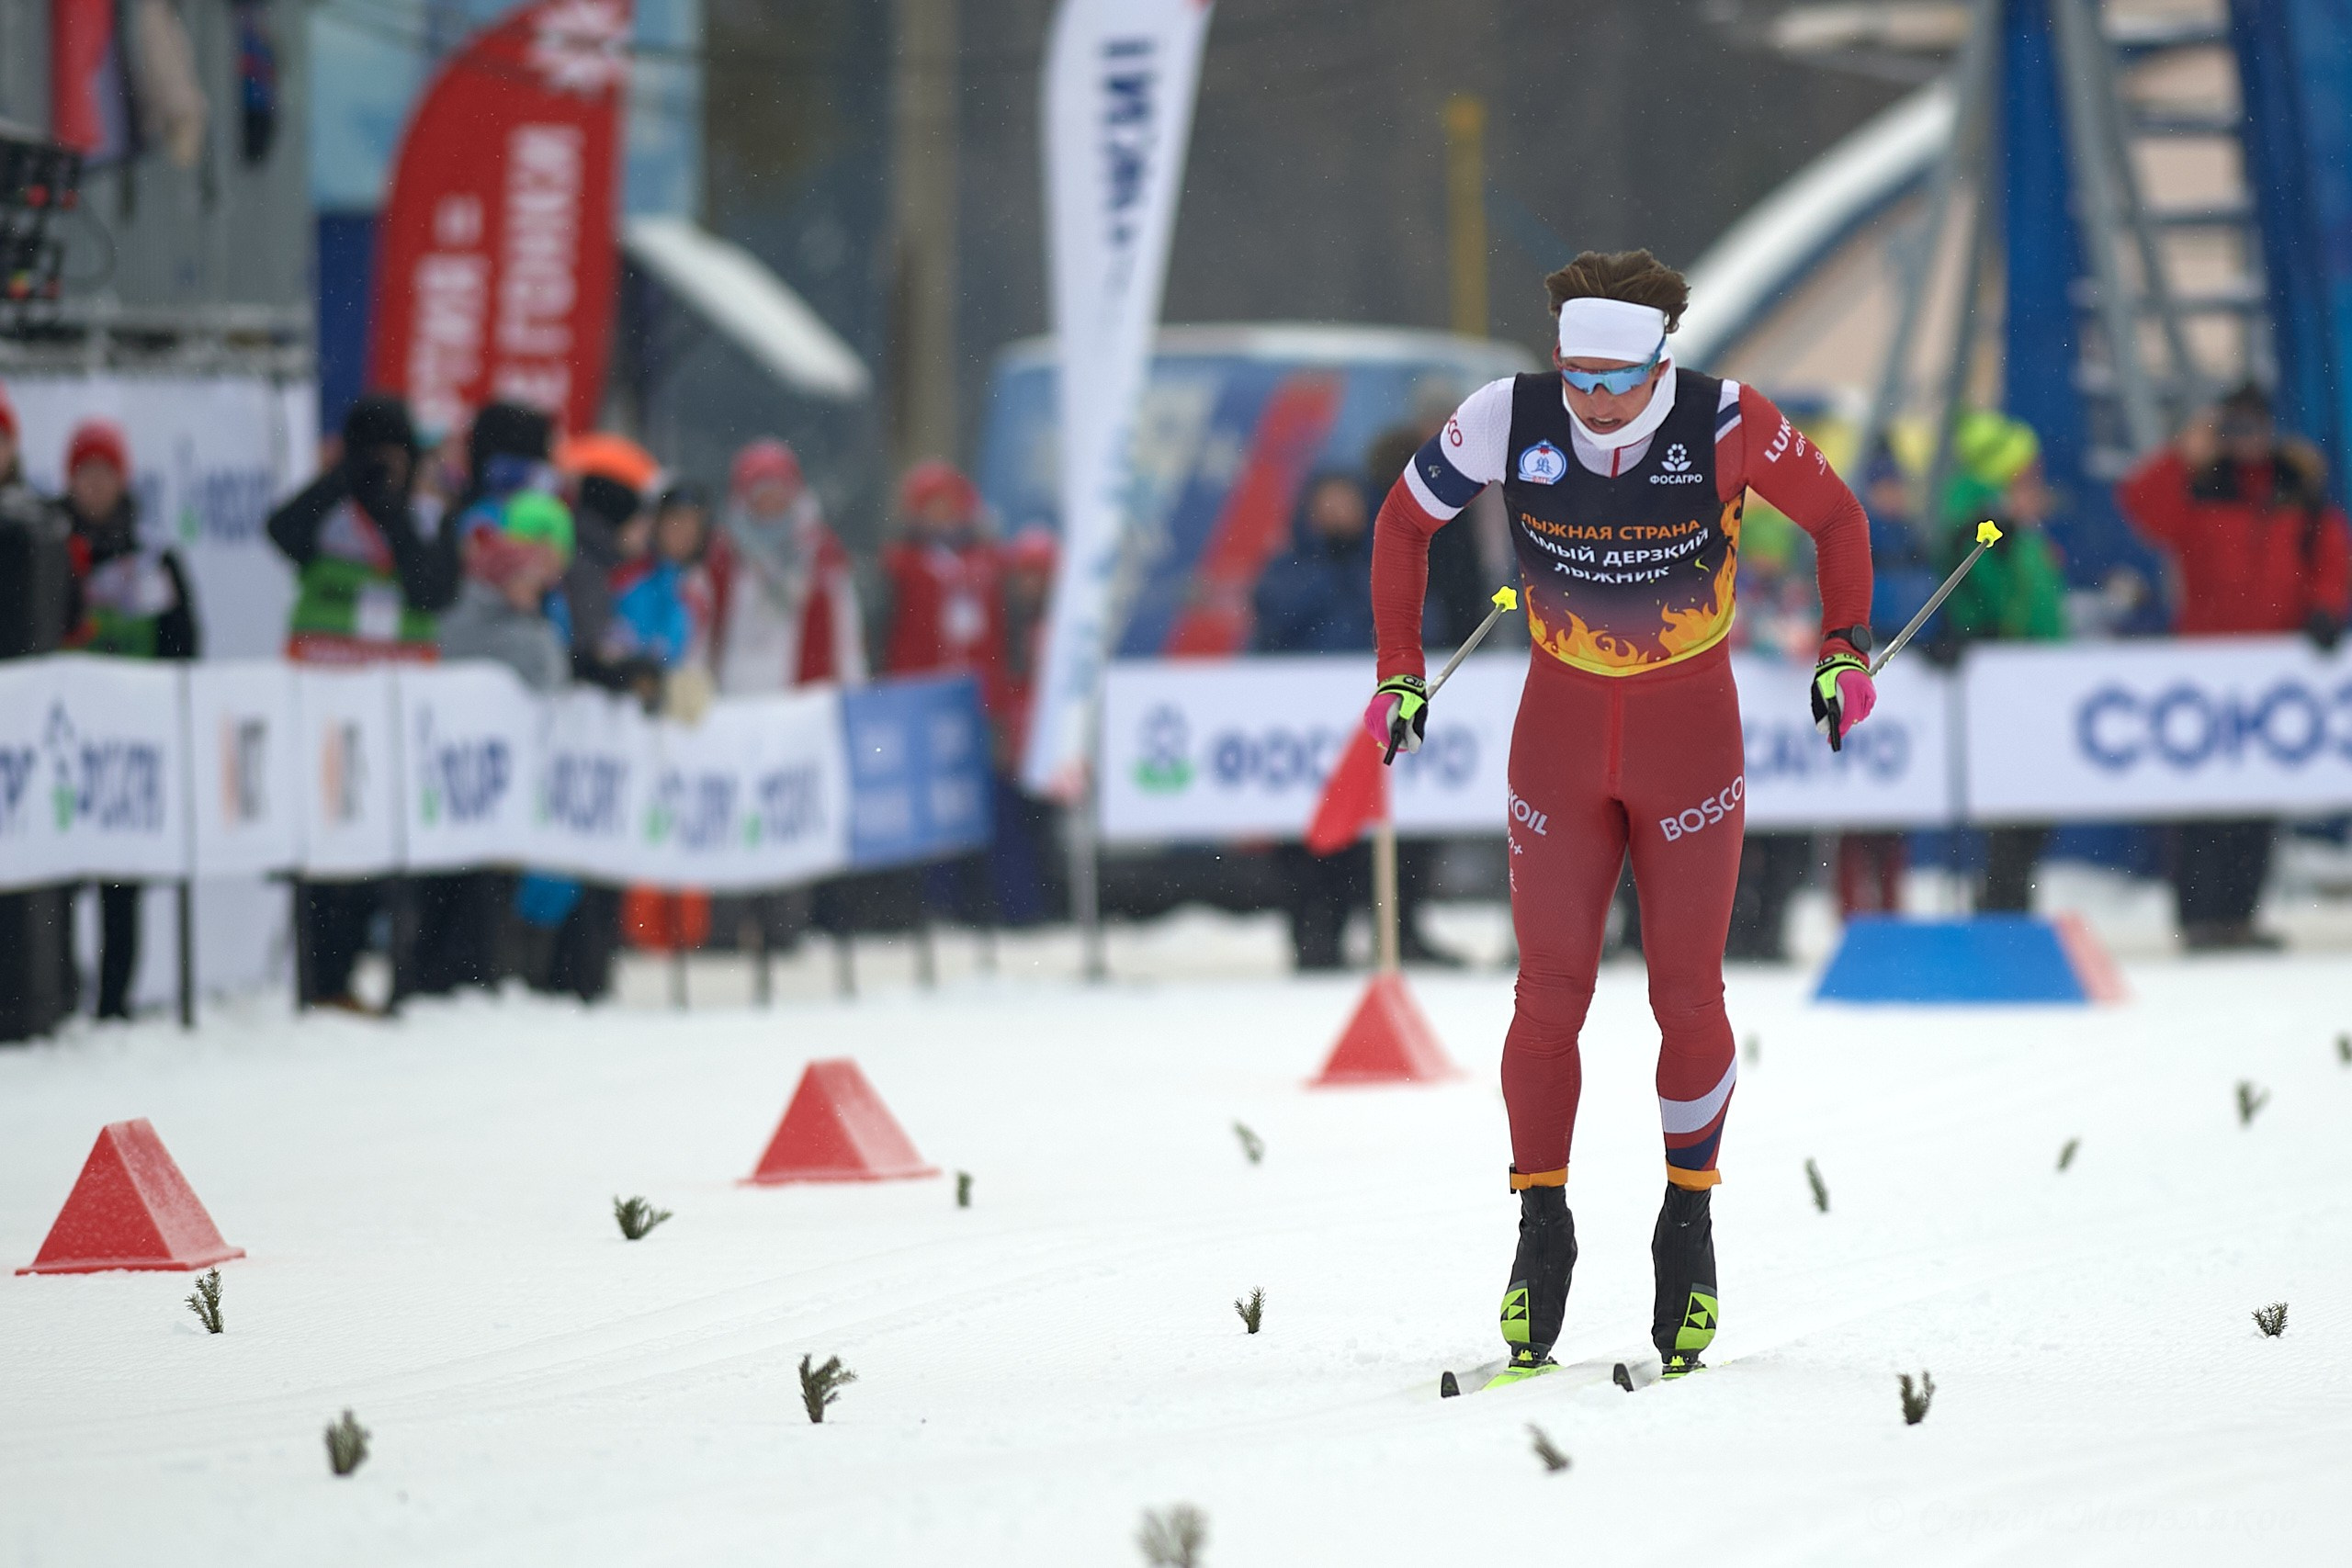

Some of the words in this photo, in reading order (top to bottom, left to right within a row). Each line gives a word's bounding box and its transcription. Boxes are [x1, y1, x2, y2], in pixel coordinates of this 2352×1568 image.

[1764, 413, 1792, 463] LUK
[1649, 473, 1703, 485] ФОСАГРО
[1521, 513, 1612, 541] ЛЫЖНАЯ
[1619, 519, 1701, 541] СТРАНА
[1521, 520, 1596, 563] САМЫЙ
[1602, 527, 1710, 567] ДЕРЗКИЙ
[1554, 562, 1670, 584] ЛЫЖНИК
[1508, 783, 1548, 836] KOIL
[1659, 775, 1744, 841] BOSCO
